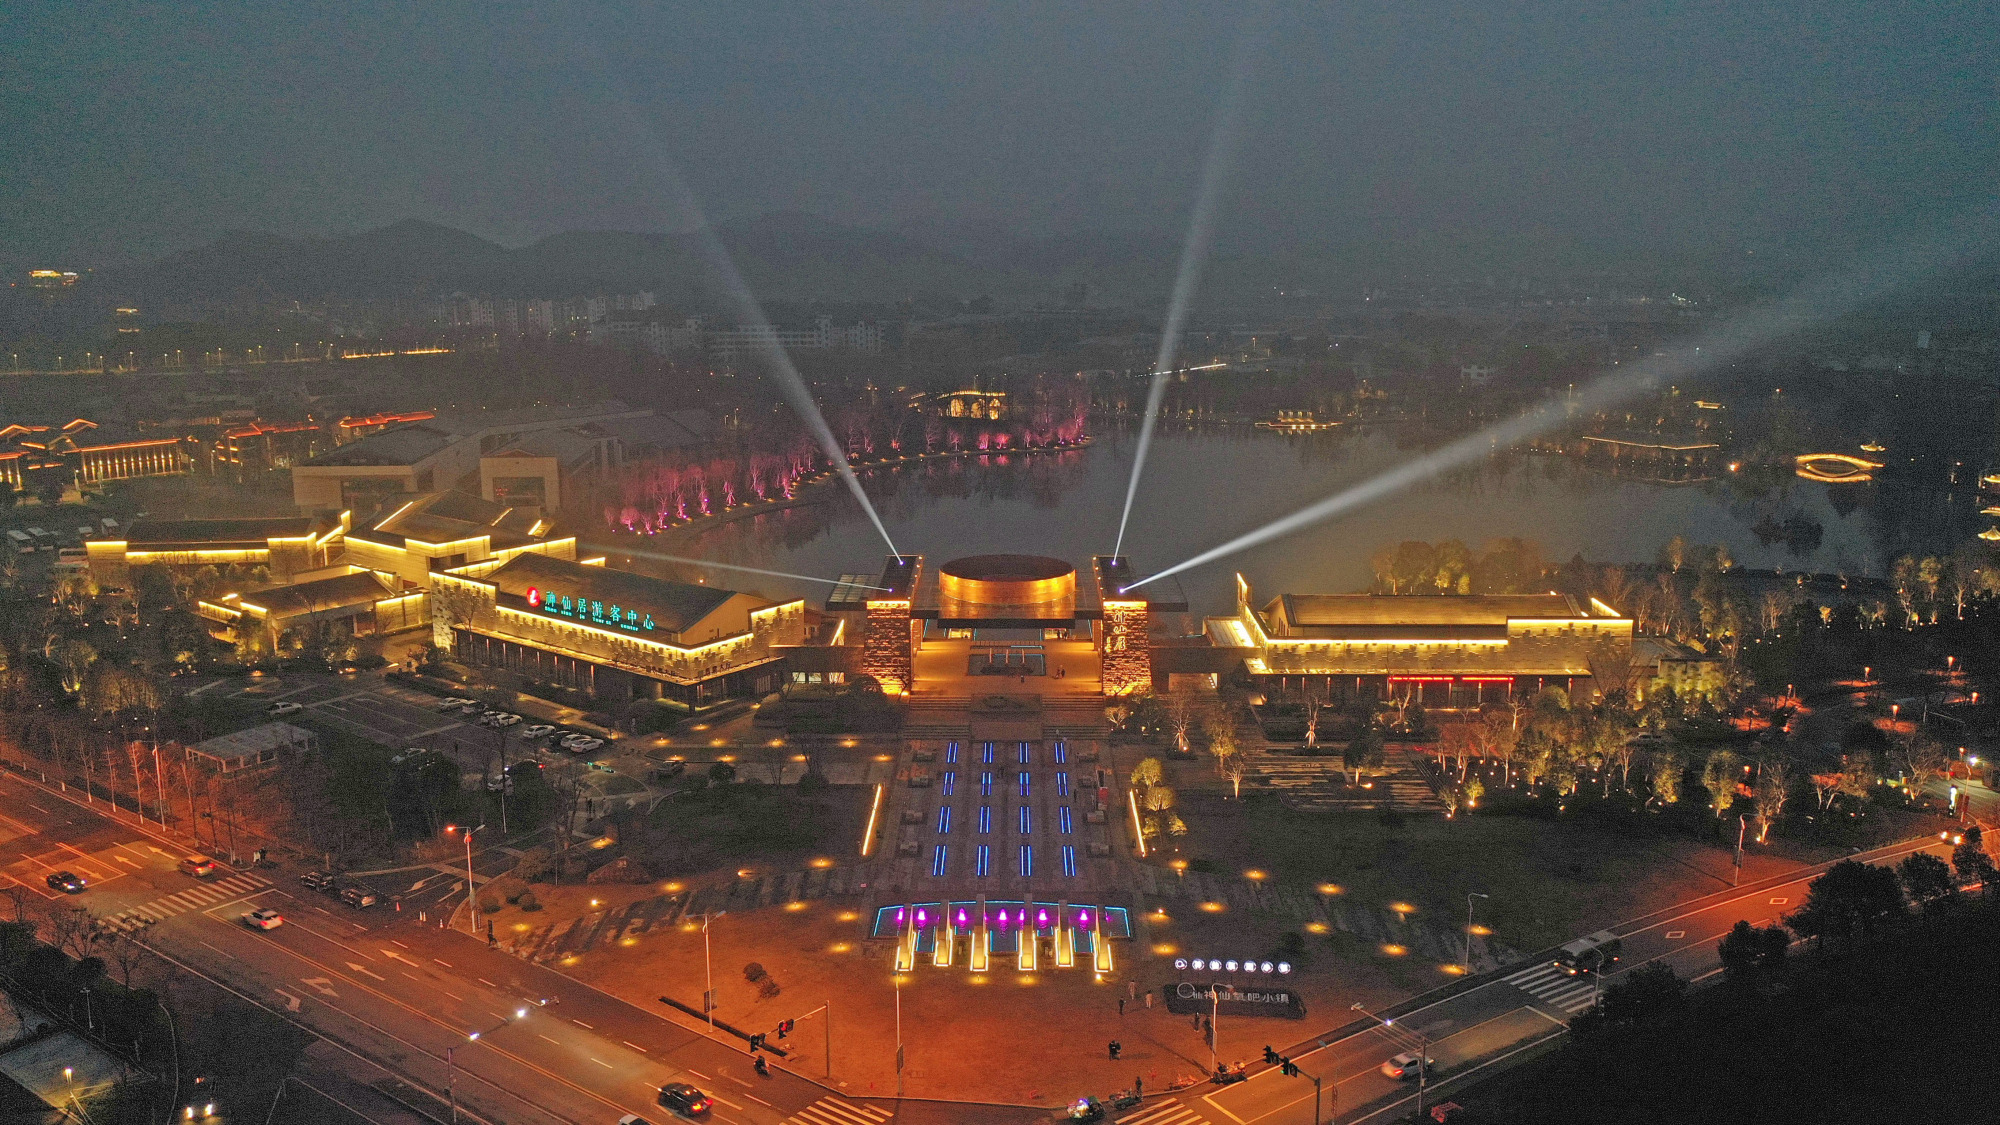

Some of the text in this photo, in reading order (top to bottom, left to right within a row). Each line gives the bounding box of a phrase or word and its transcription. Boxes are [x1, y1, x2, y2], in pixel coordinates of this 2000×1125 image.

[545, 591, 655, 630] 神仙居游客中心
